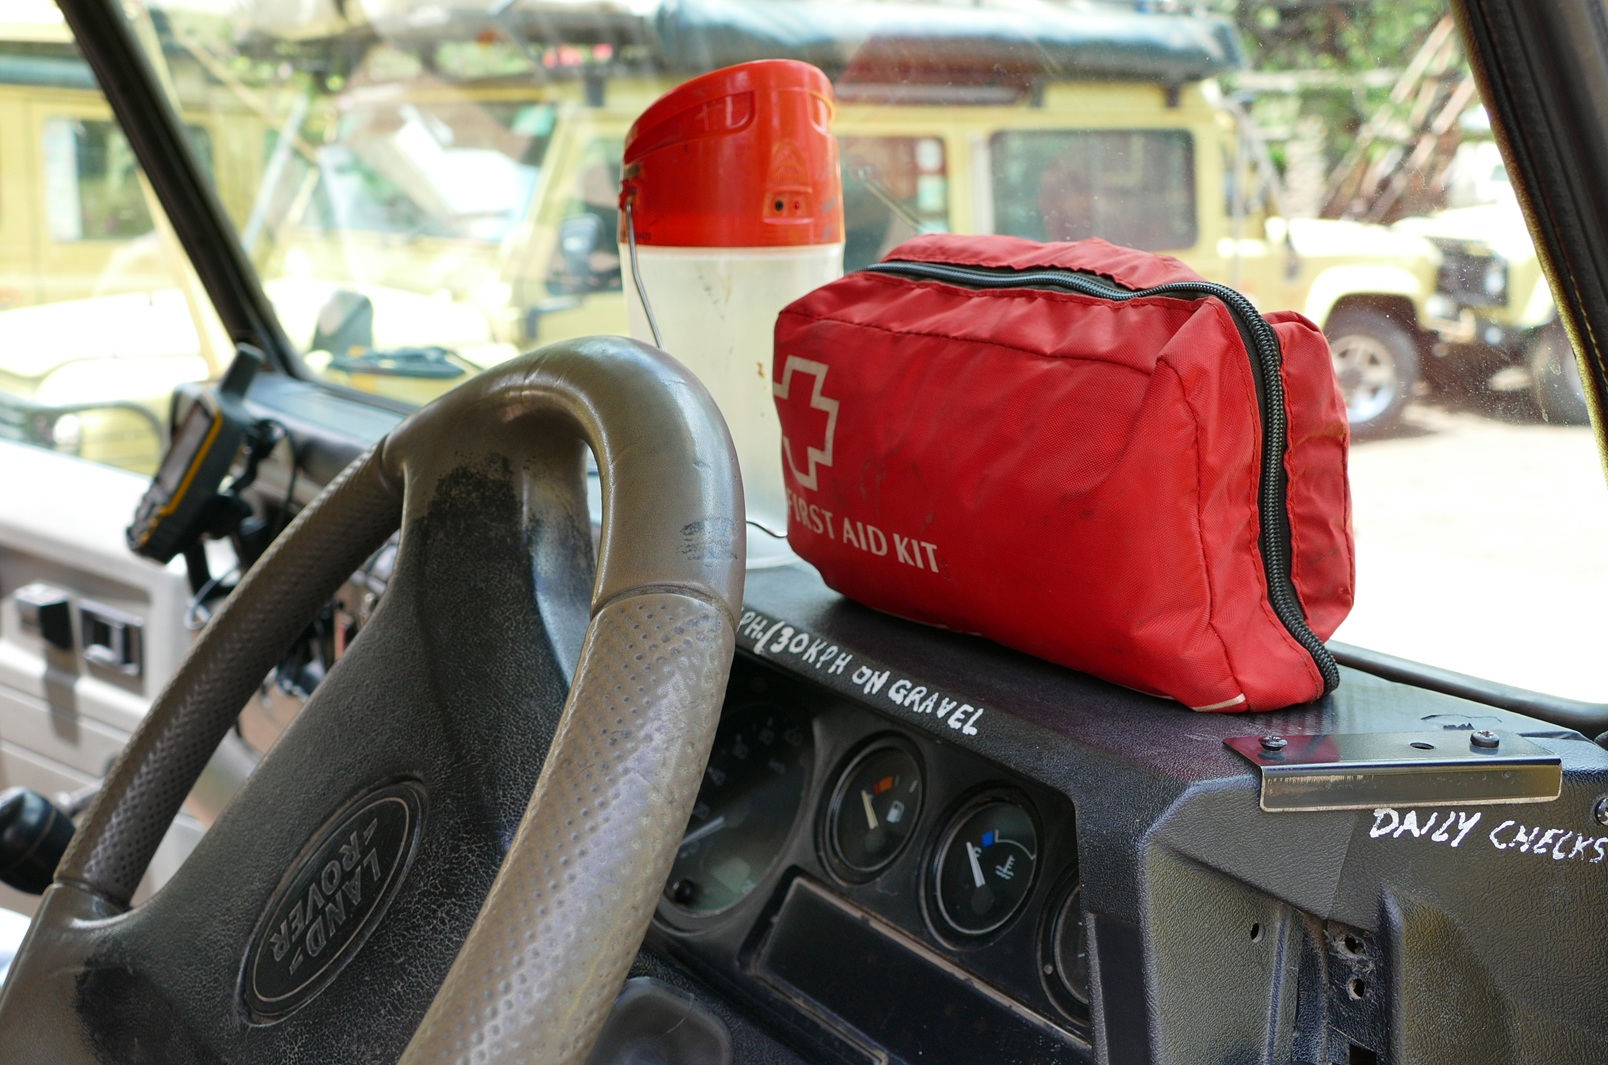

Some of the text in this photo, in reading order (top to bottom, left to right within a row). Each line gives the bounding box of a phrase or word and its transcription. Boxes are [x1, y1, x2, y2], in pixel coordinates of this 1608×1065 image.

[787, 488, 940, 573] FIRST AID KIT
[852, 665, 891, 694] ON
[888, 679, 984, 736] GRAVEL
[1369, 808, 1608, 863] DAILY CHECKS
[269, 830, 361, 962] ROVER
[305, 848, 382, 958] LAND
